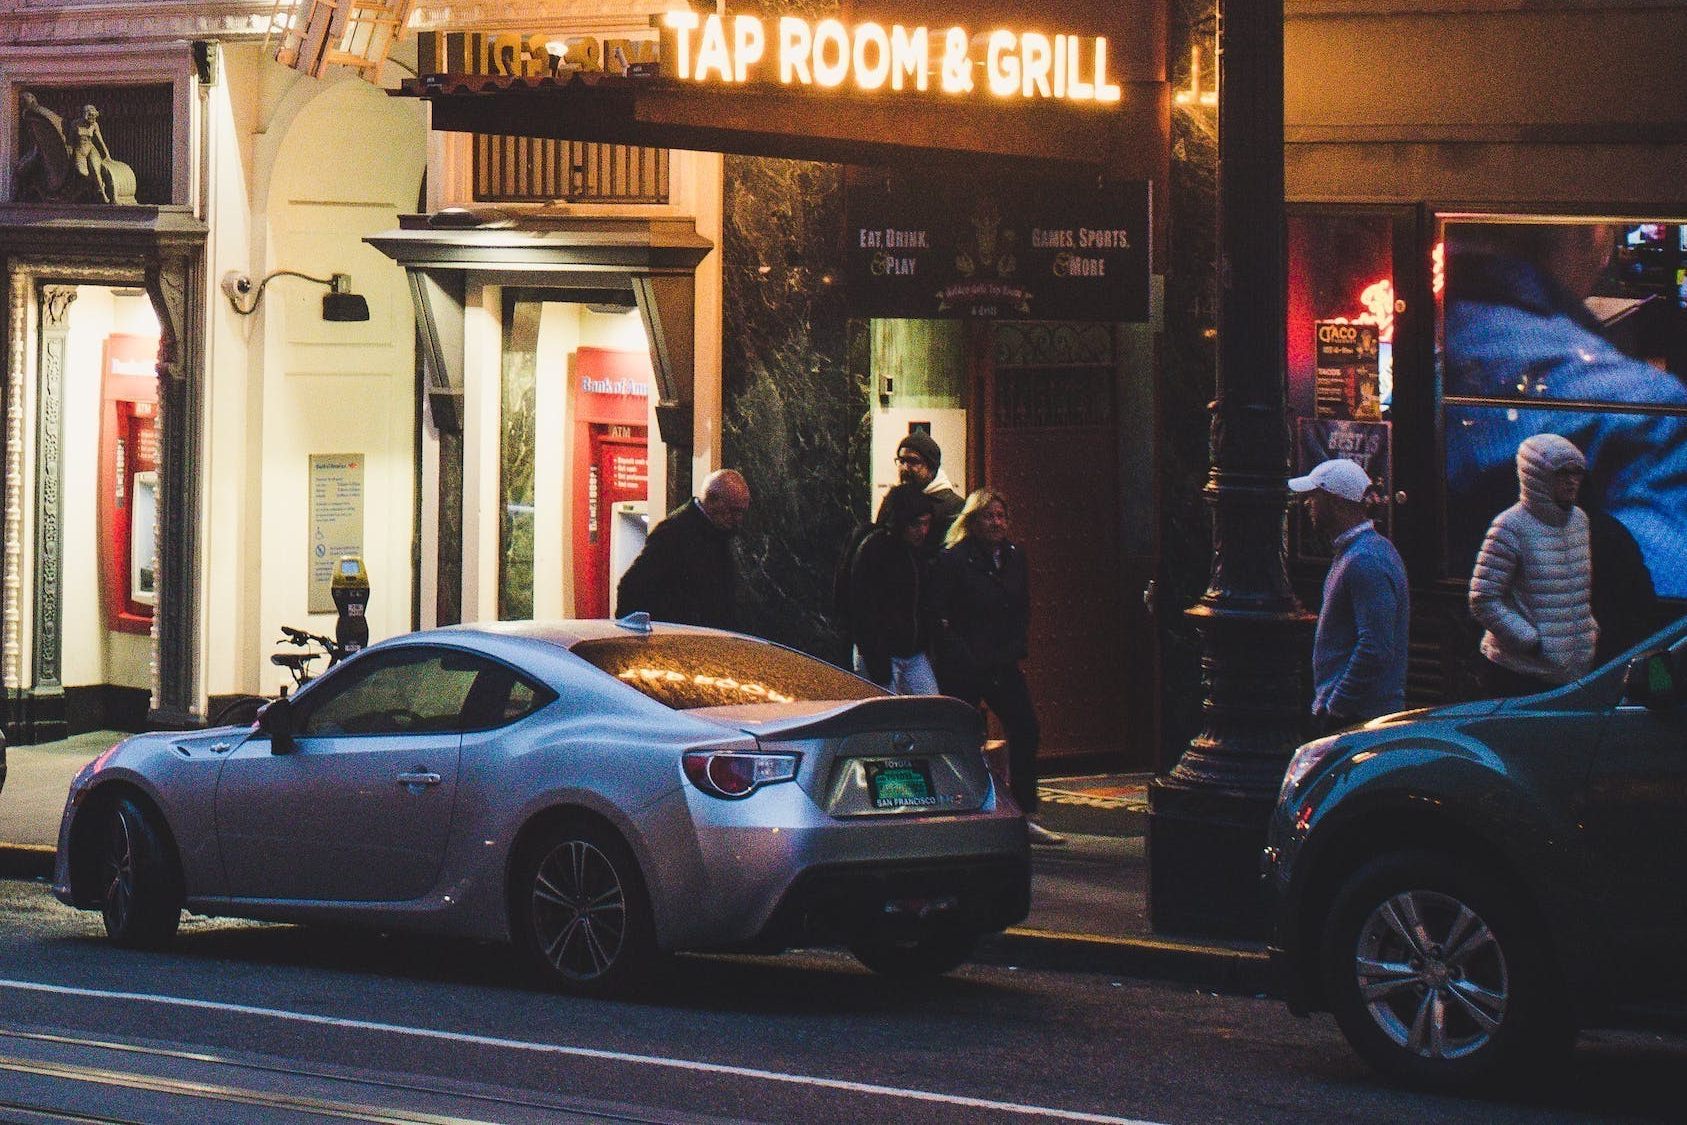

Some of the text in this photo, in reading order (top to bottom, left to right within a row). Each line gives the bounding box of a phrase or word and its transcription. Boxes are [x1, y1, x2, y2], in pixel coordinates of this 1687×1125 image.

[667, 10, 765, 82] TAP
[779, 16, 928, 91] ROOM
[941, 26, 975, 94] &
[986, 29, 1122, 102] GRILL
[1318, 325, 1358, 343] TACO
[581, 375, 612, 393] Bank
[612, 426, 631, 438] ATM
[876, 797, 893, 807] SAN
[893, 796, 936, 806] FRANCISCO
